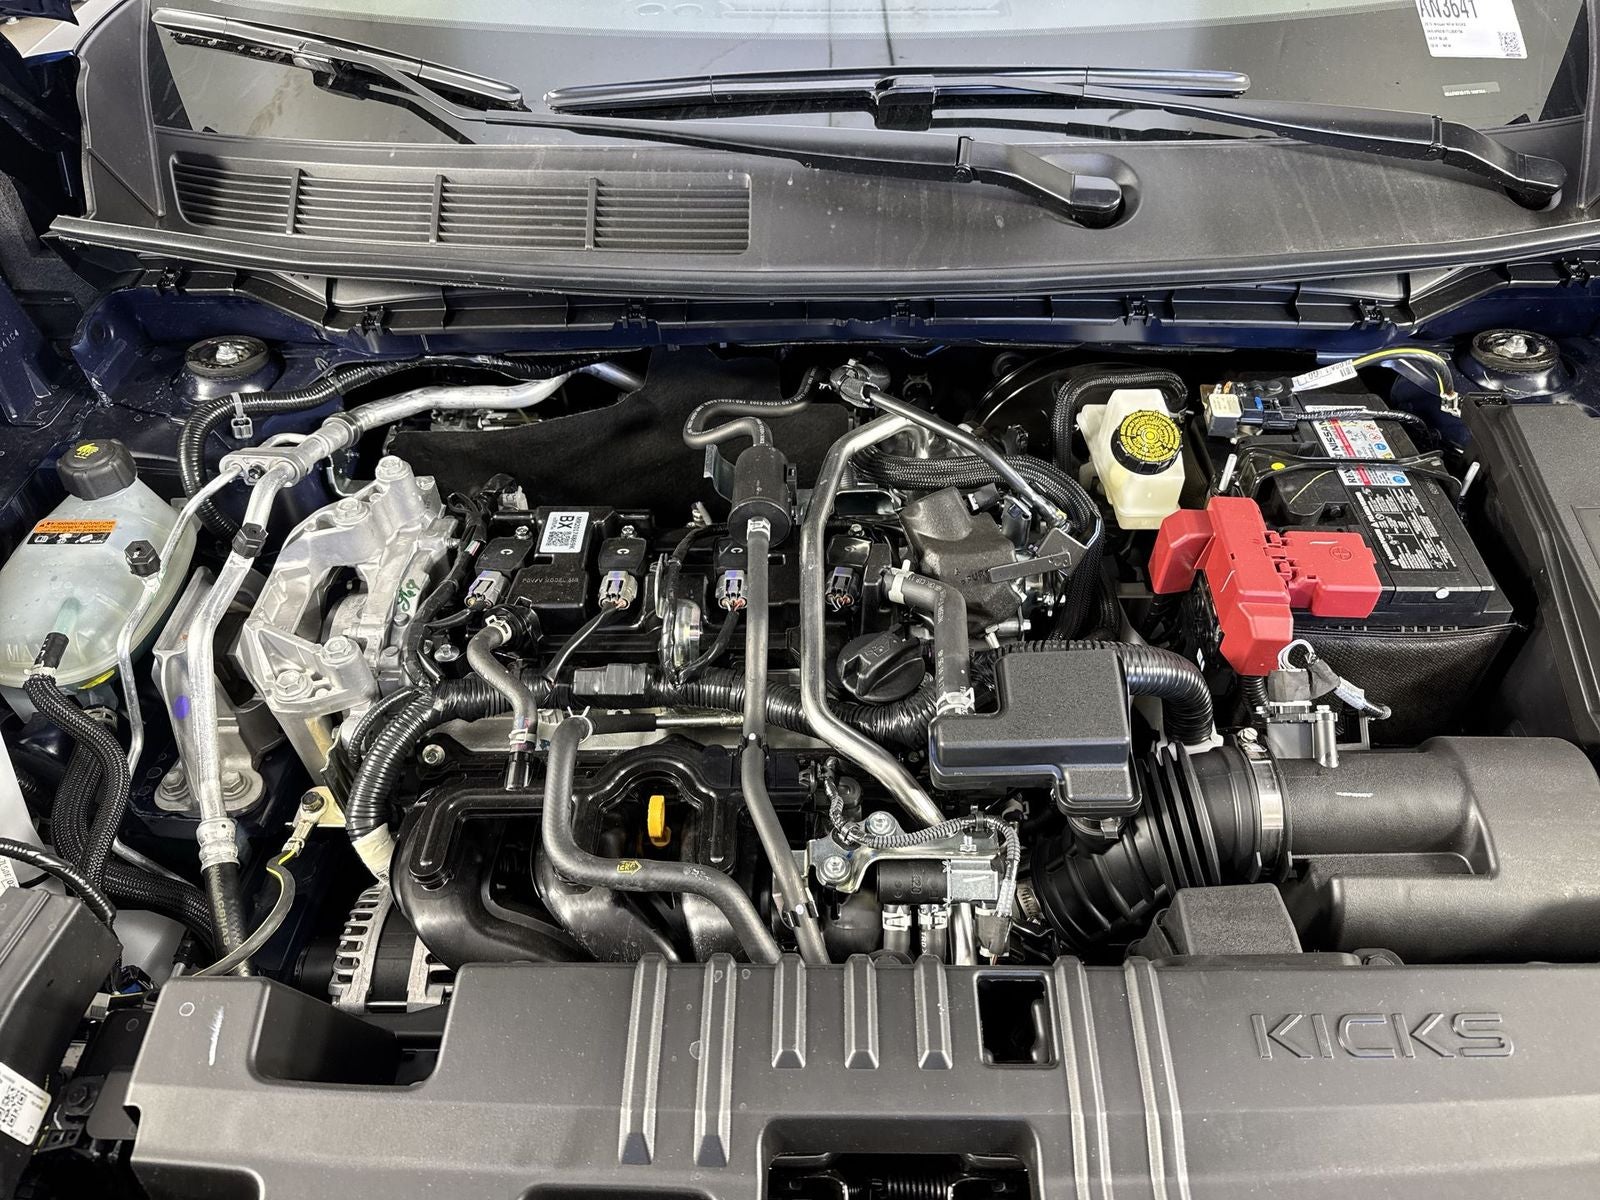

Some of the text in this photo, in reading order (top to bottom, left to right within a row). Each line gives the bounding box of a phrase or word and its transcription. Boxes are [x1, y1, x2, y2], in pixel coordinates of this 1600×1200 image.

[1420, 0, 1478, 18] AN3641
[558, 515, 575, 529] BX
[1251, 1012, 1515, 1058] KICKS
